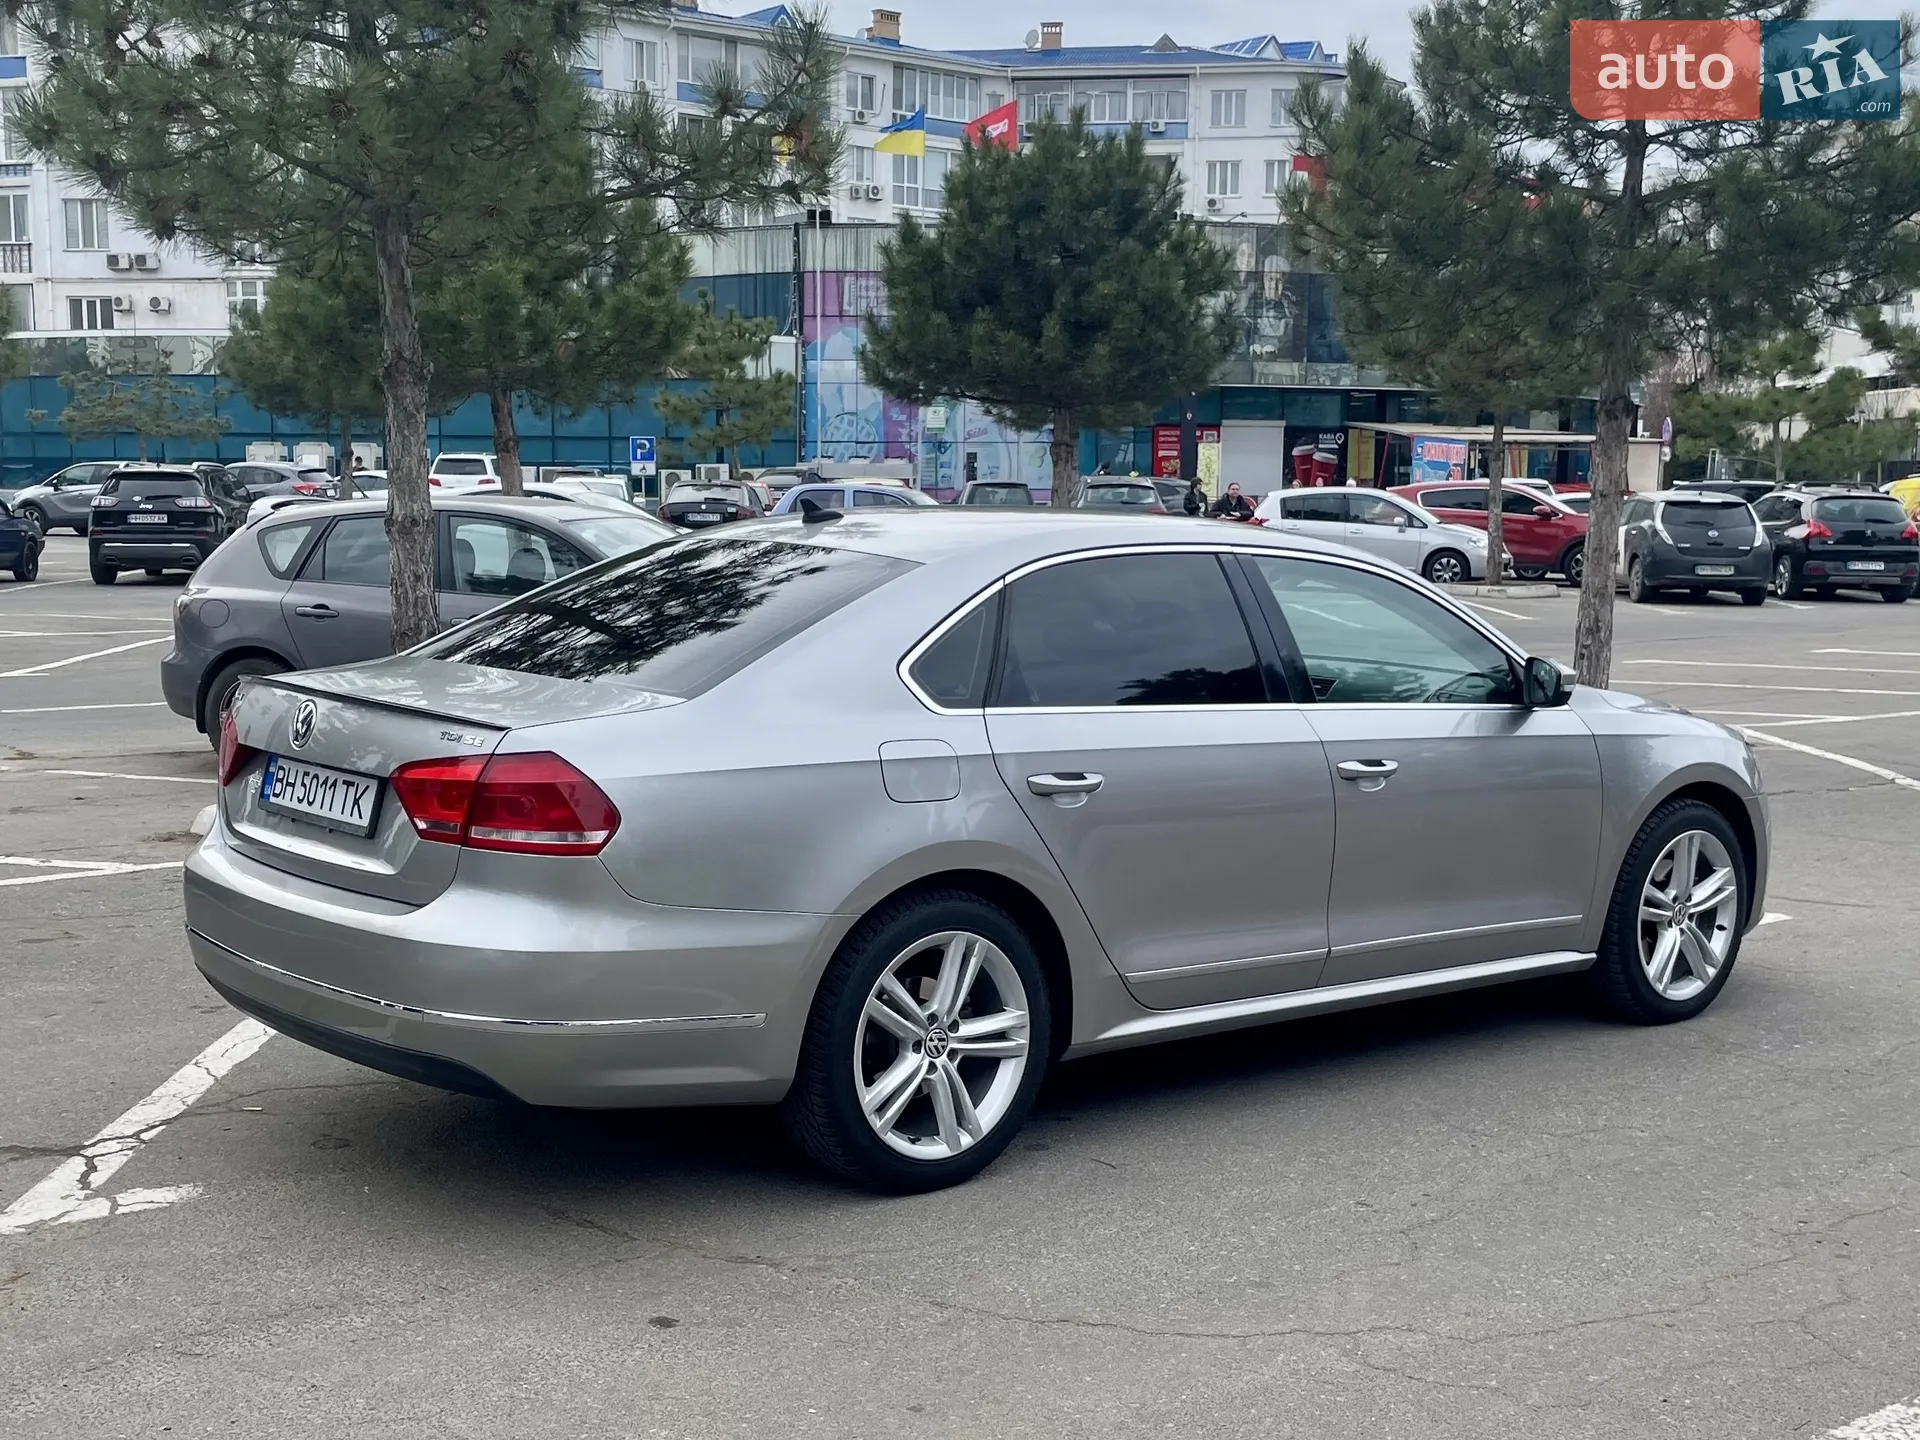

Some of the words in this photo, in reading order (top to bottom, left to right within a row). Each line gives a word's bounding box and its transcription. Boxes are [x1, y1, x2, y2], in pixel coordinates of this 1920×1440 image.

[636, 439, 651, 460] P
[440, 730, 463, 743] TDI
[463, 735, 485, 747] SE
[272, 765, 298, 802] BH
[297, 771, 339, 812] 5011
[341, 779, 370, 820] TK
